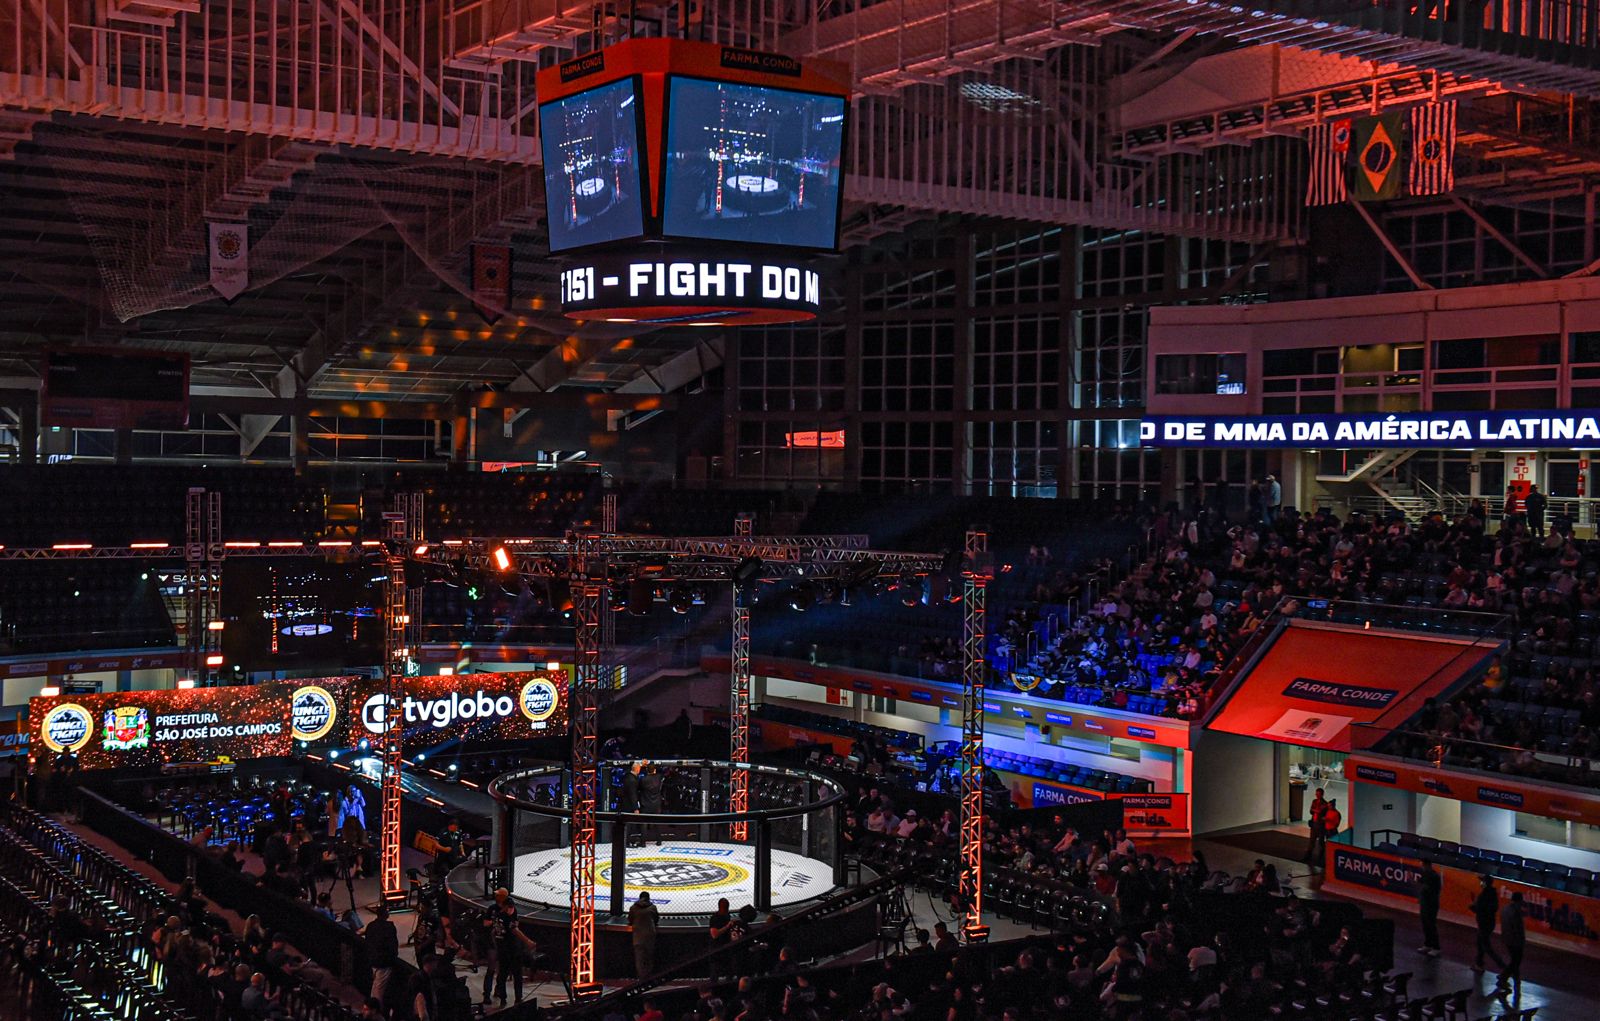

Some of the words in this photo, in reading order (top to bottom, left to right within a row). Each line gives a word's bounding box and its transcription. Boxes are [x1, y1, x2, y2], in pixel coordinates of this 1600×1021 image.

[561, 62, 581, 78] FARMA
[582, 55, 603, 71] CONDE
[724, 50, 760, 65] FARMA
[762, 56, 800, 71] CONDE
[629, 262, 752, 297] FIGHT
[762, 264, 800, 301] DO
[1164, 422, 1206, 440] DE
[1214, 422, 1287, 441] MMA
[1292, 421, 1329, 441] DA
[1334, 415, 1473, 441] AMÉRICA
[1479, 417, 1600, 440] LATINA
[1290, 680, 1339, 697] FARMA
[1341, 689, 1393, 703] CONDE
[402, 690, 514, 728] tvglobo
[526, 700, 552, 709] FIGHT
[155, 712, 219, 727] PREFEITURA
[293, 715, 328, 726] FIGHT
[50, 729, 86, 741] FIGHT
[155, 727, 180, 742] SÃO
[180, 725, 218, 740] JOSÉ
[219, 725, 244, 738] DOS
[244, 722, 291, 736] CAMPOS
[1357, 767, 1376, 776] FARMA
[1376, 770, 1395, 779] CONDE
[1034, 787, 1066, 804] FARMA
[1479, 788, 1499, 798] FARMA
[1500, 792, 1522, 803] CONDE
[1337, 855, 1382, 877] FARMA
